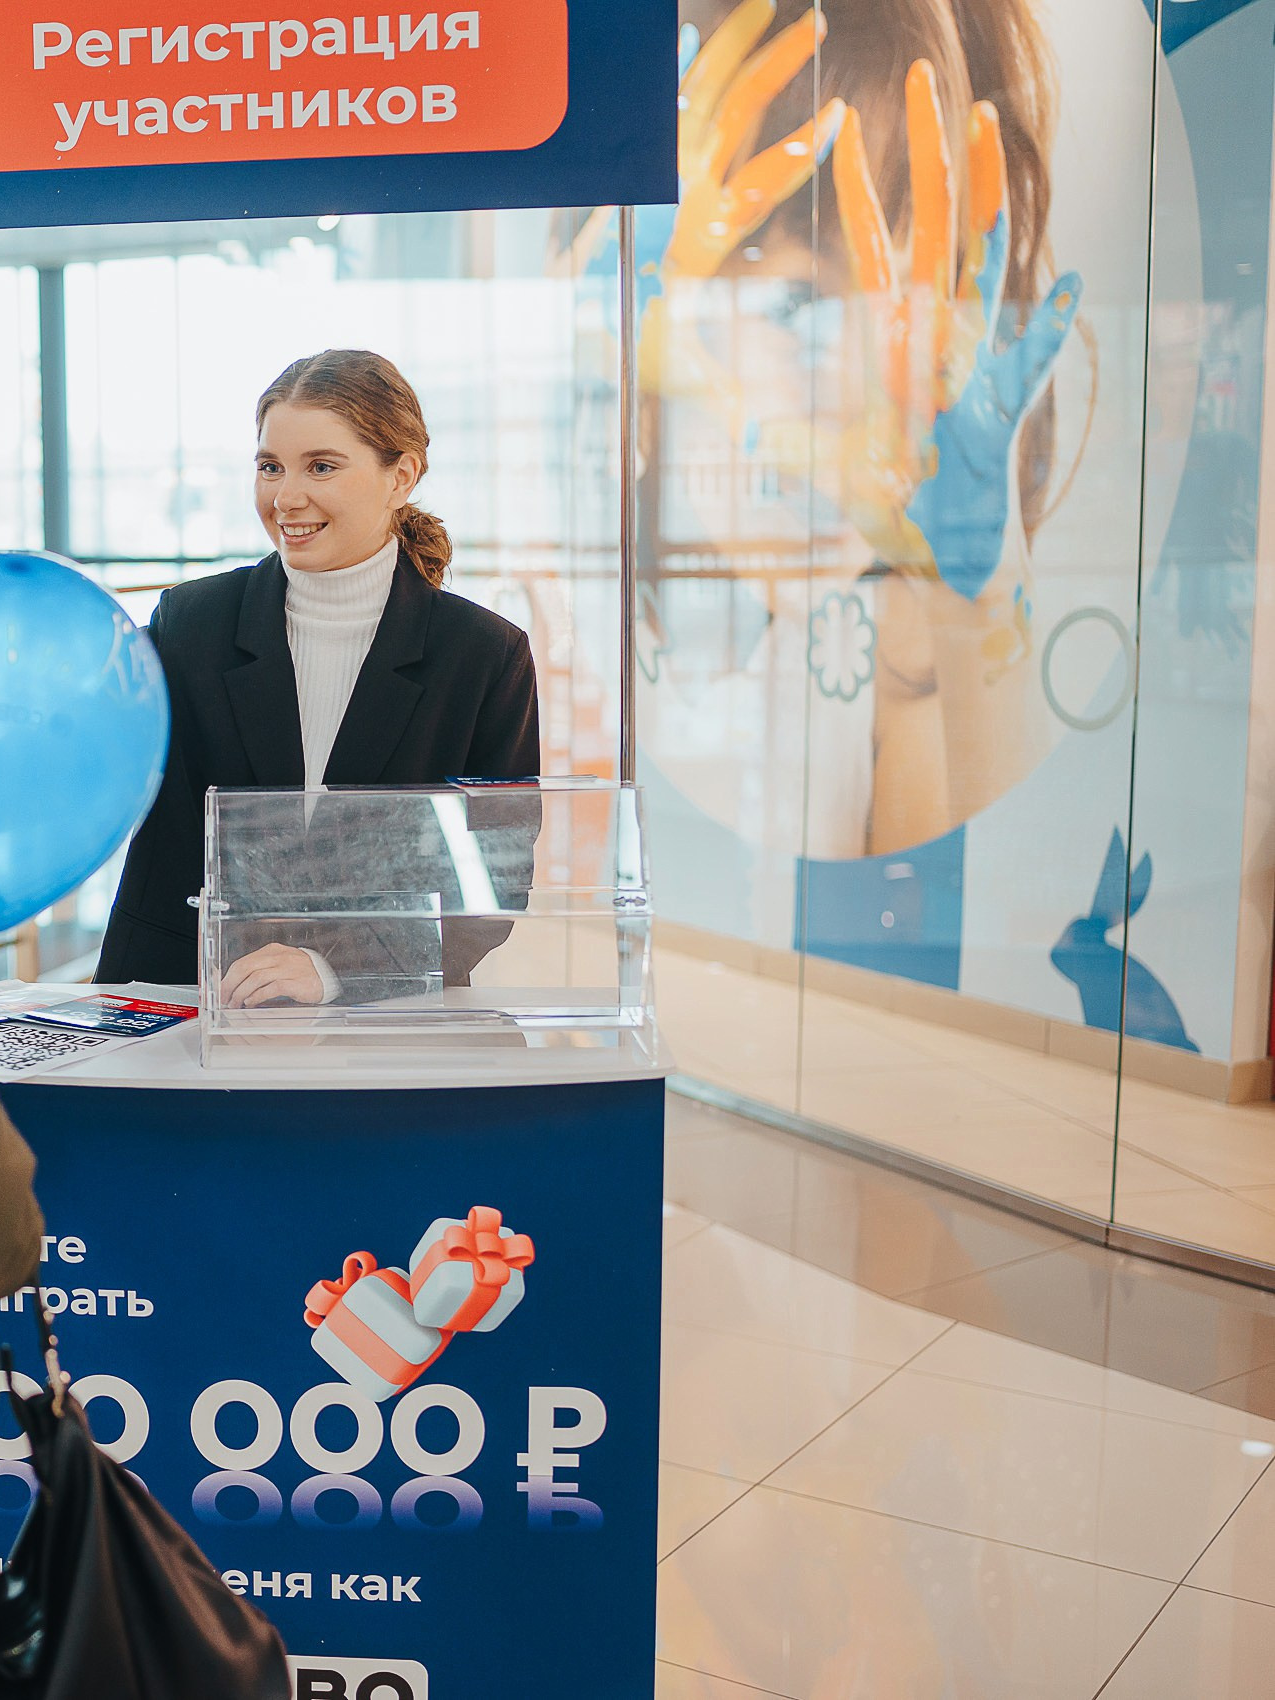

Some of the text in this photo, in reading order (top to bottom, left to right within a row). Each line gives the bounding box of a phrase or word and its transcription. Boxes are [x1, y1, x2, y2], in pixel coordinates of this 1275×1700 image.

[32, 10, 480, 71] Регистрация
[53, 84, 458, 152] участников
[190, 1379, 486, 1477] 000
[214, 1569, 312, 1599] еня
[331, 1573, 422, 1602] как
